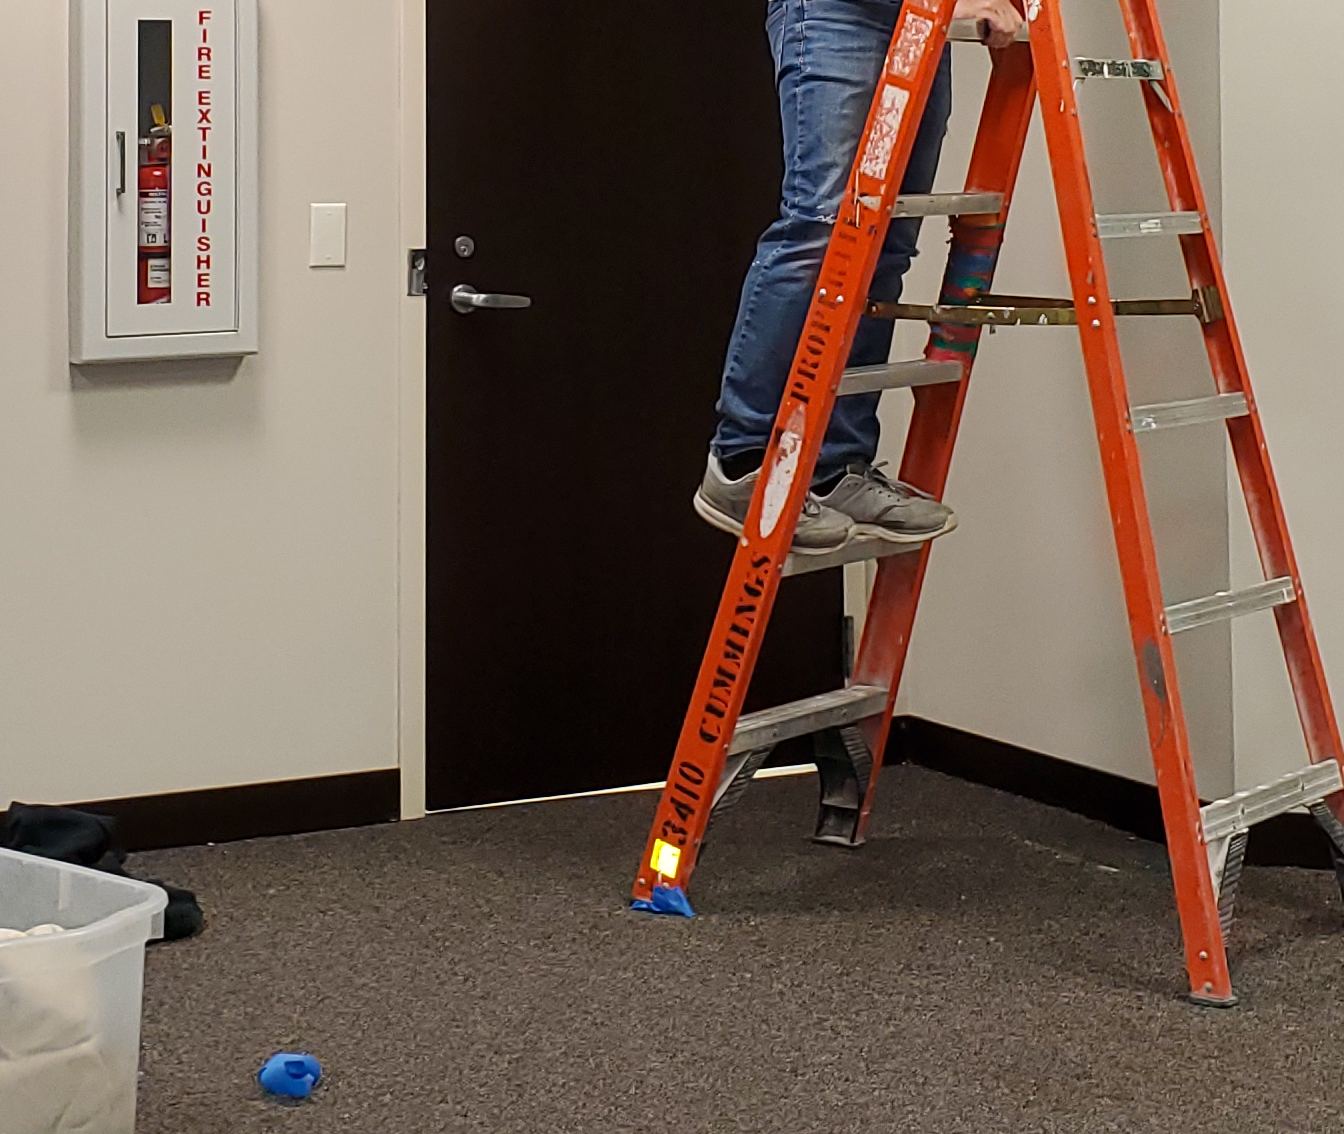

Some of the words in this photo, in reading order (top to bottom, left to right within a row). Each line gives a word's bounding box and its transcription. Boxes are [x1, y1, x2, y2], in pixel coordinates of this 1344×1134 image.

[197, 10, 212, 80] FIRE
[196, 90, 212, 307] EXTINGUISHER
[662, 761, 705, 846] 3410
[699, 551, 771, 744] CUMMINGS
